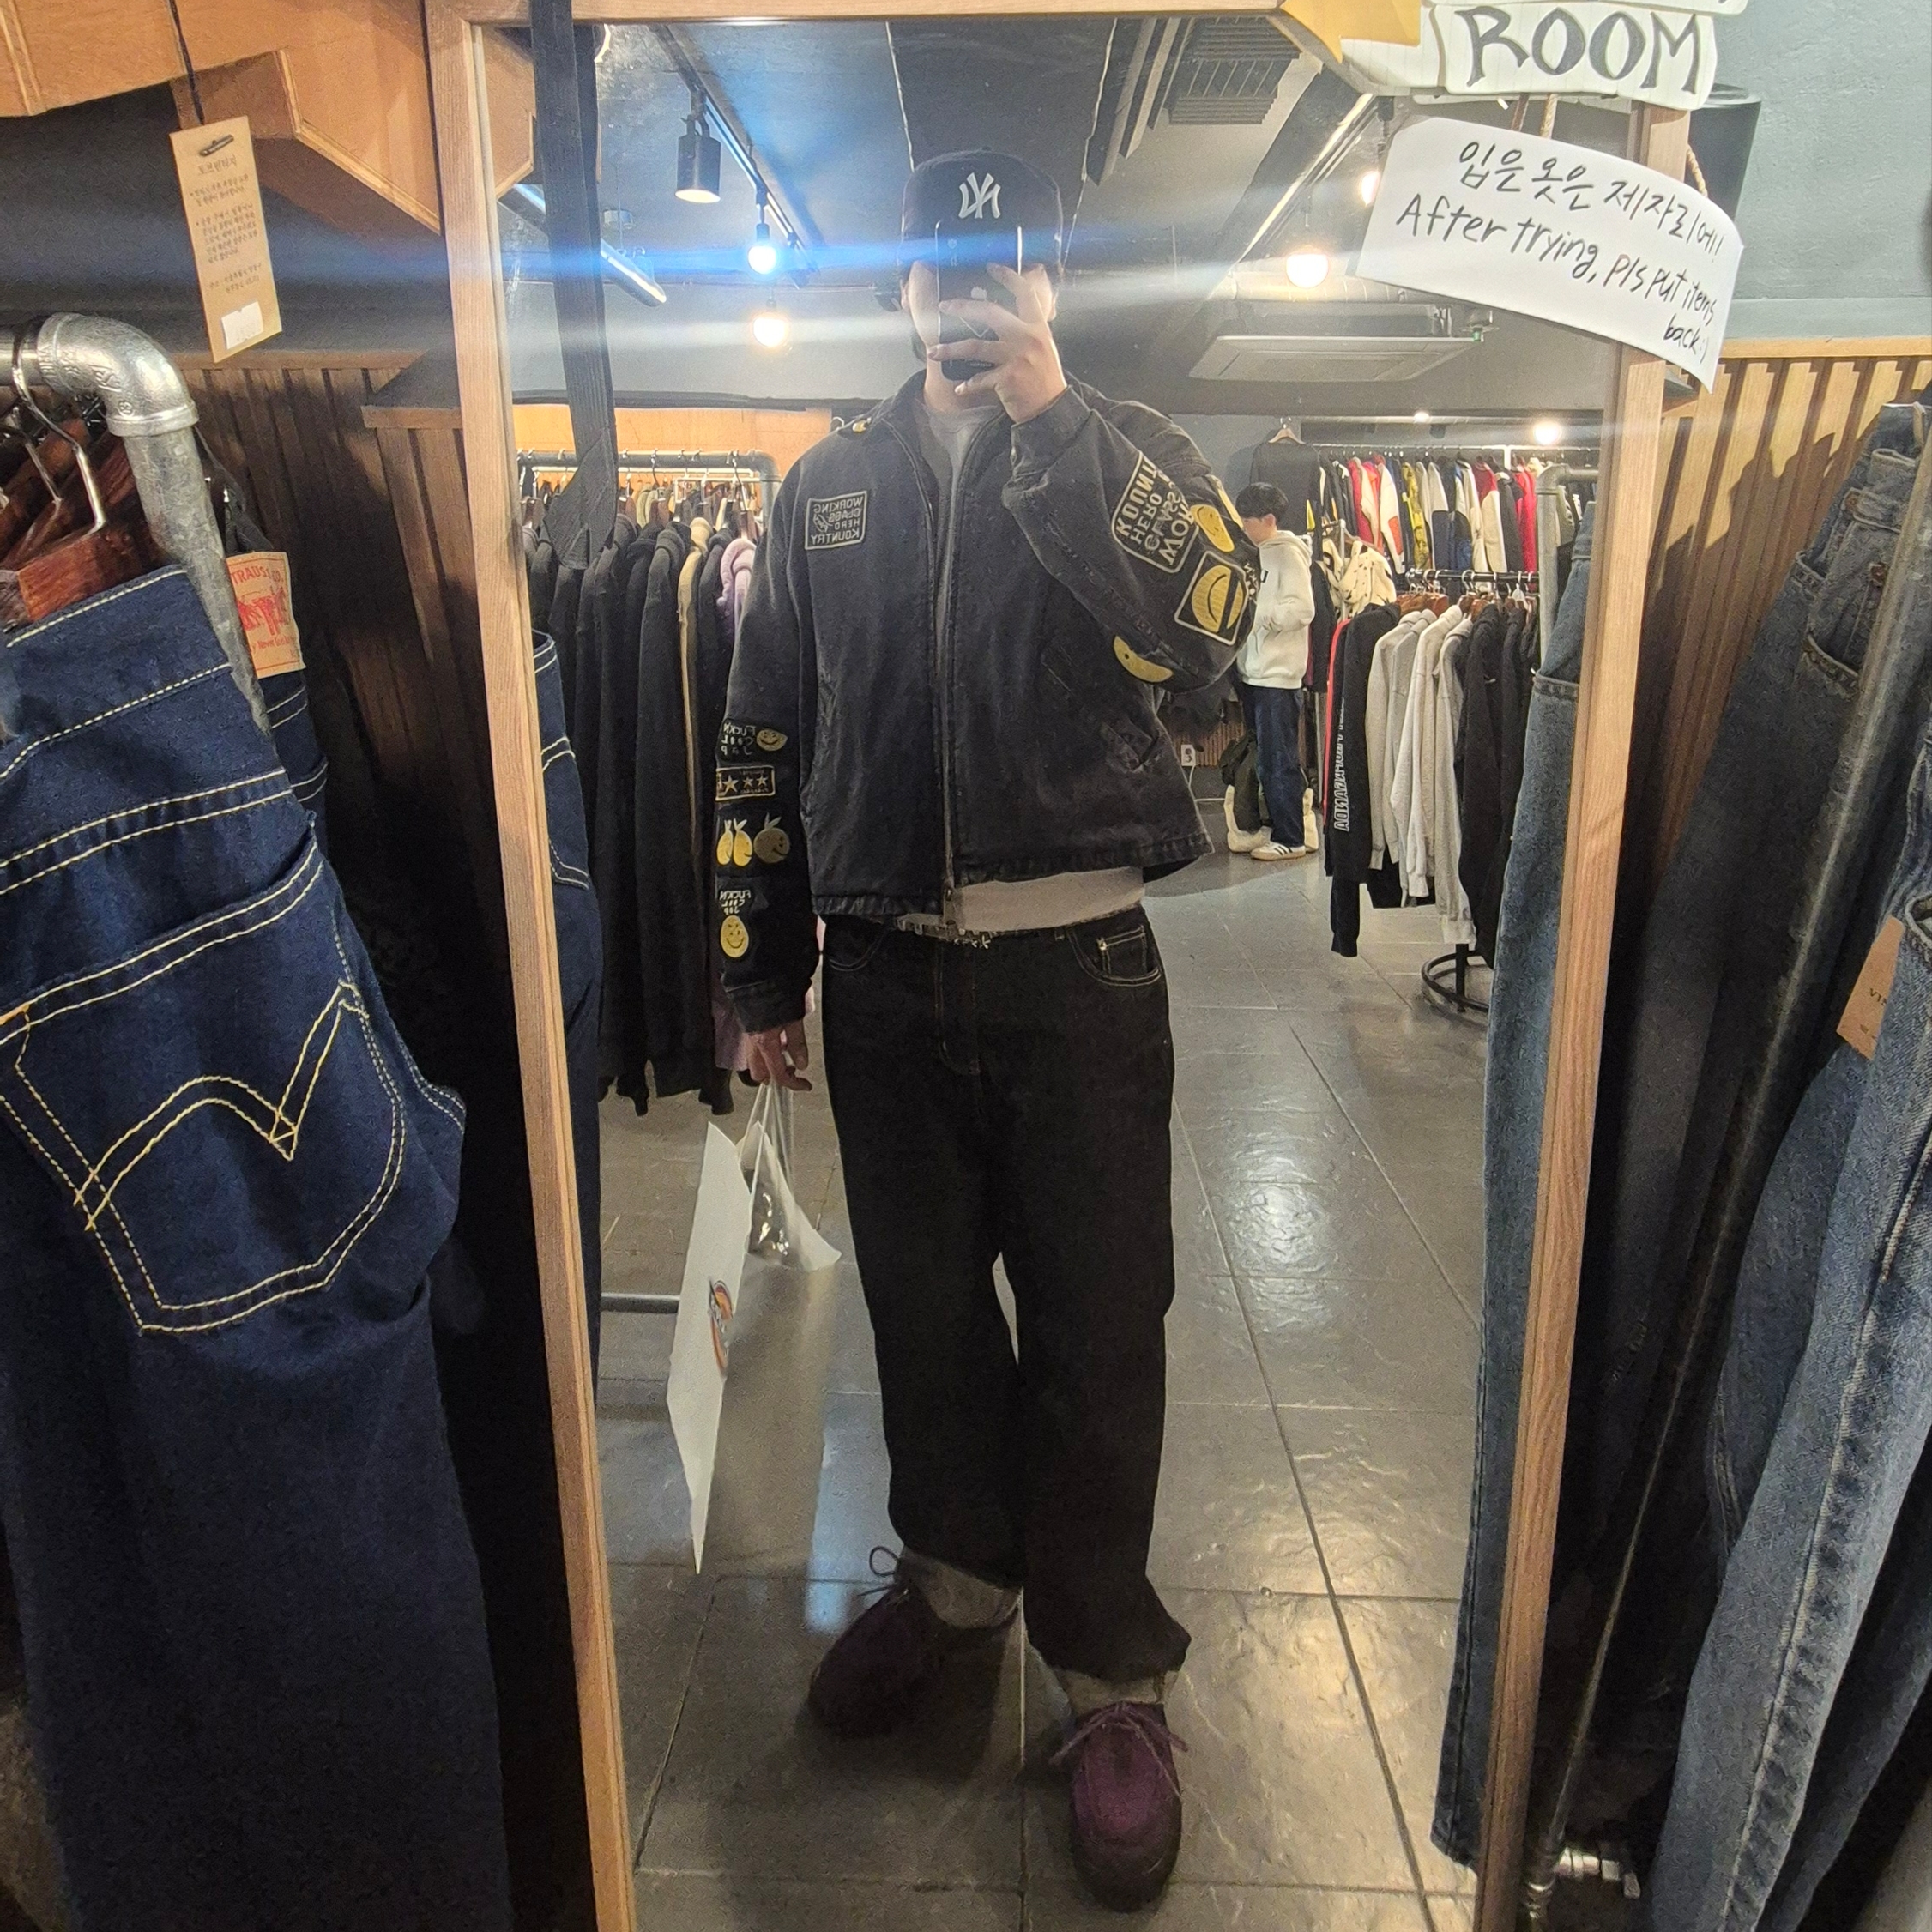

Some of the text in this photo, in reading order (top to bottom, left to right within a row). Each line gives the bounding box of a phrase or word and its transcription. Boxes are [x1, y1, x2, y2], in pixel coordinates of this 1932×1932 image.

[1455, 5, 1698, 94] ROOM
[1459, 142, 1524, 191] 입은
[1531, 157, 1593, 211] 옷은
[1396, 193, 1507, 242] After
[1510, 217, 1598, 283] trying,
